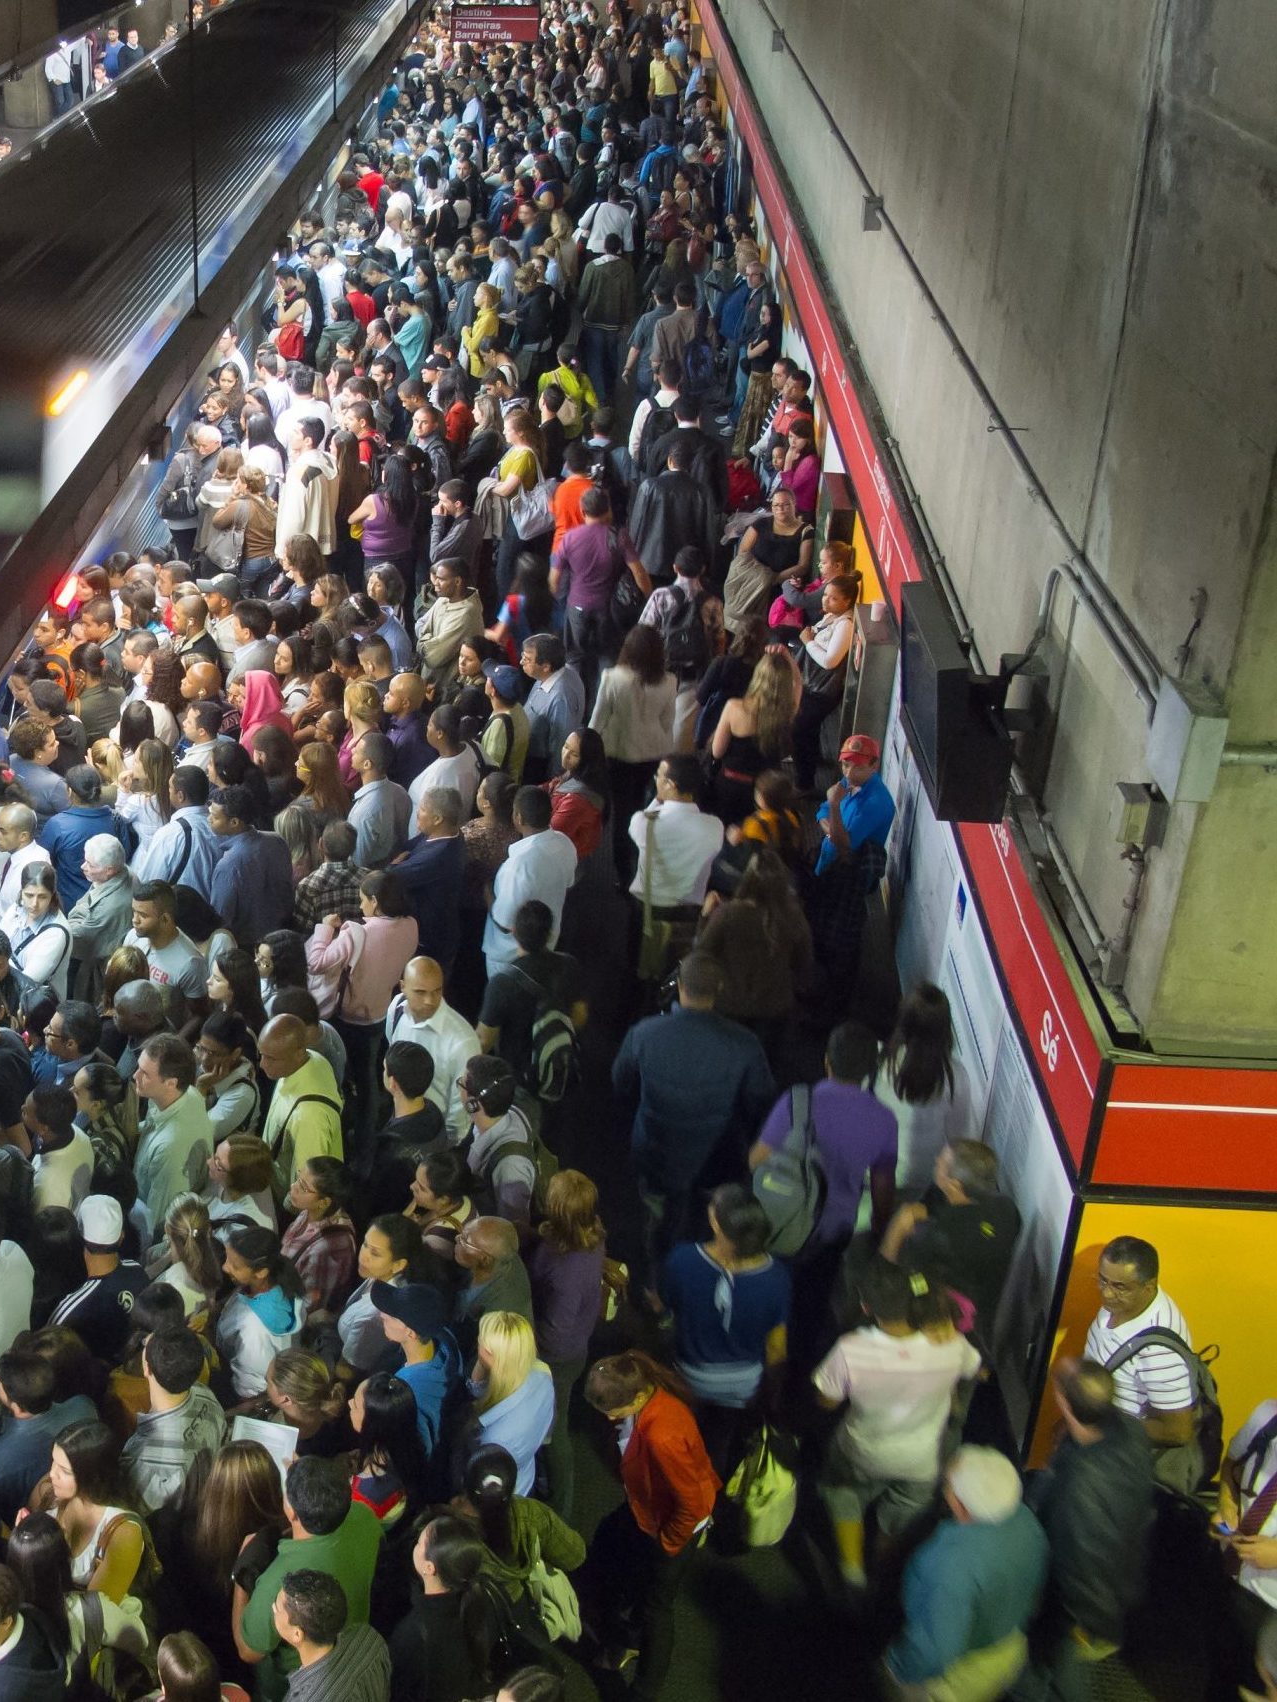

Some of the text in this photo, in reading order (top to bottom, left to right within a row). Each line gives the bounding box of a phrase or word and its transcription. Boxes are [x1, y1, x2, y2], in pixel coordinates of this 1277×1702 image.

[456, 8, 492, 17] Destino
[455, 21, 502, 30] Palmeiras
[454, 30, 512, 40] Barra Funda
[1039, 1009, 1060, 1073] Sé
